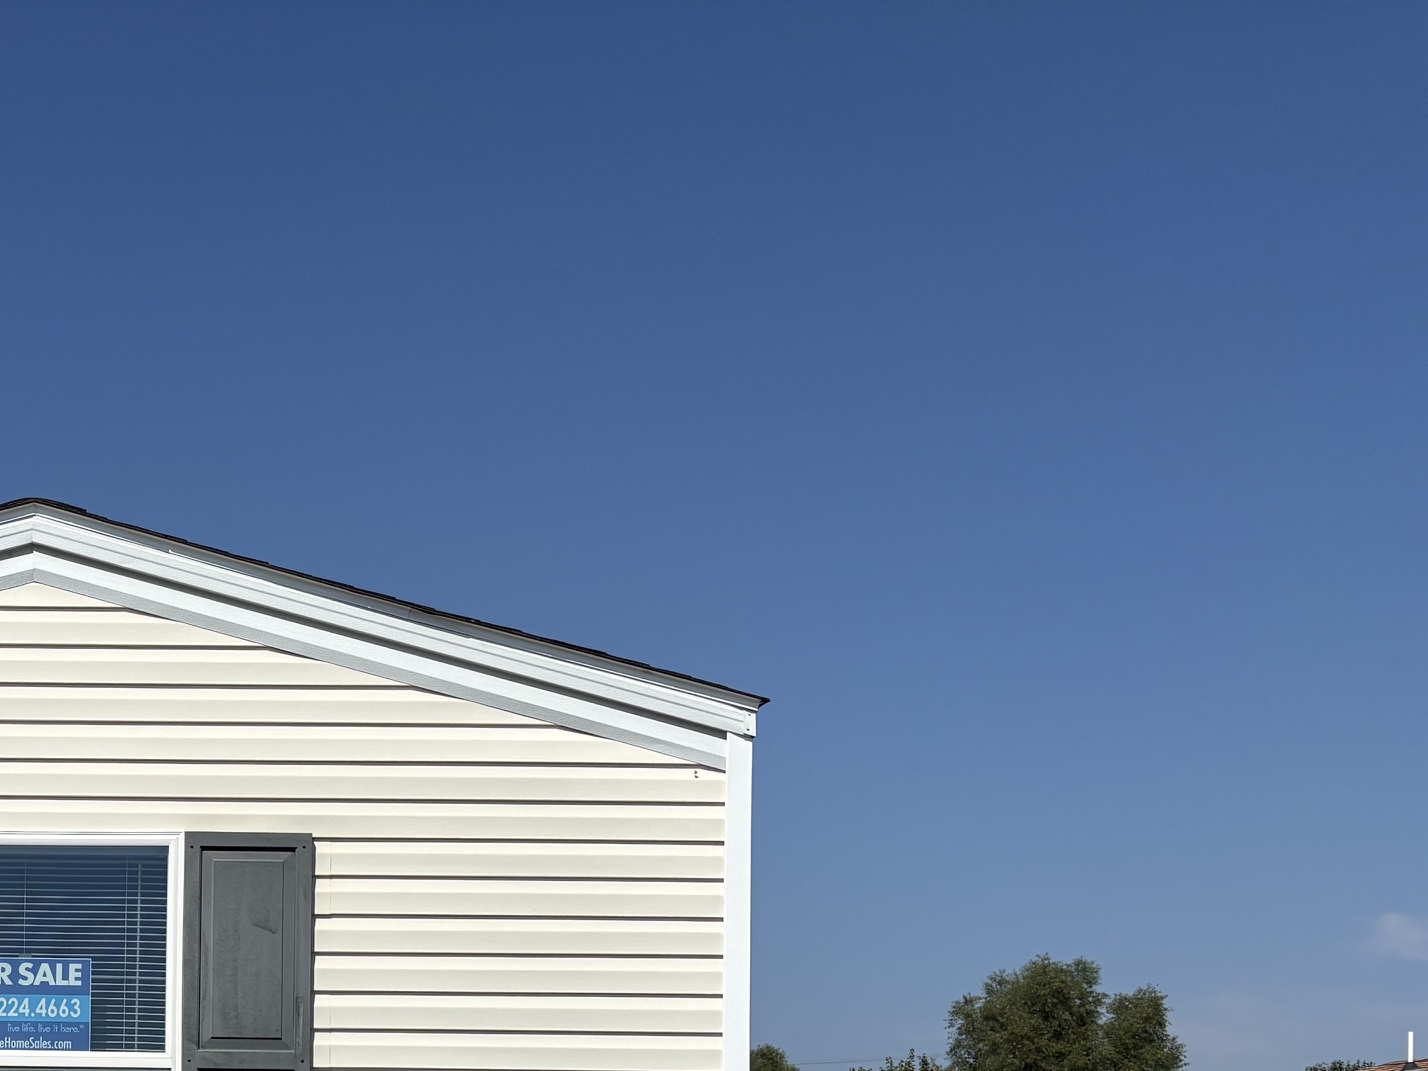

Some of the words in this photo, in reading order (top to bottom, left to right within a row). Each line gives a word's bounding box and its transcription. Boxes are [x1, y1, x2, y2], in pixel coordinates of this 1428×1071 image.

[18, 963, 82, 986] SALE
[7, 1022, 20, 1033] live
[21, 1023, 36, 1033] life.
[37, 1022, 51, 1033] live
[52, 1024, 59, 1033] it
